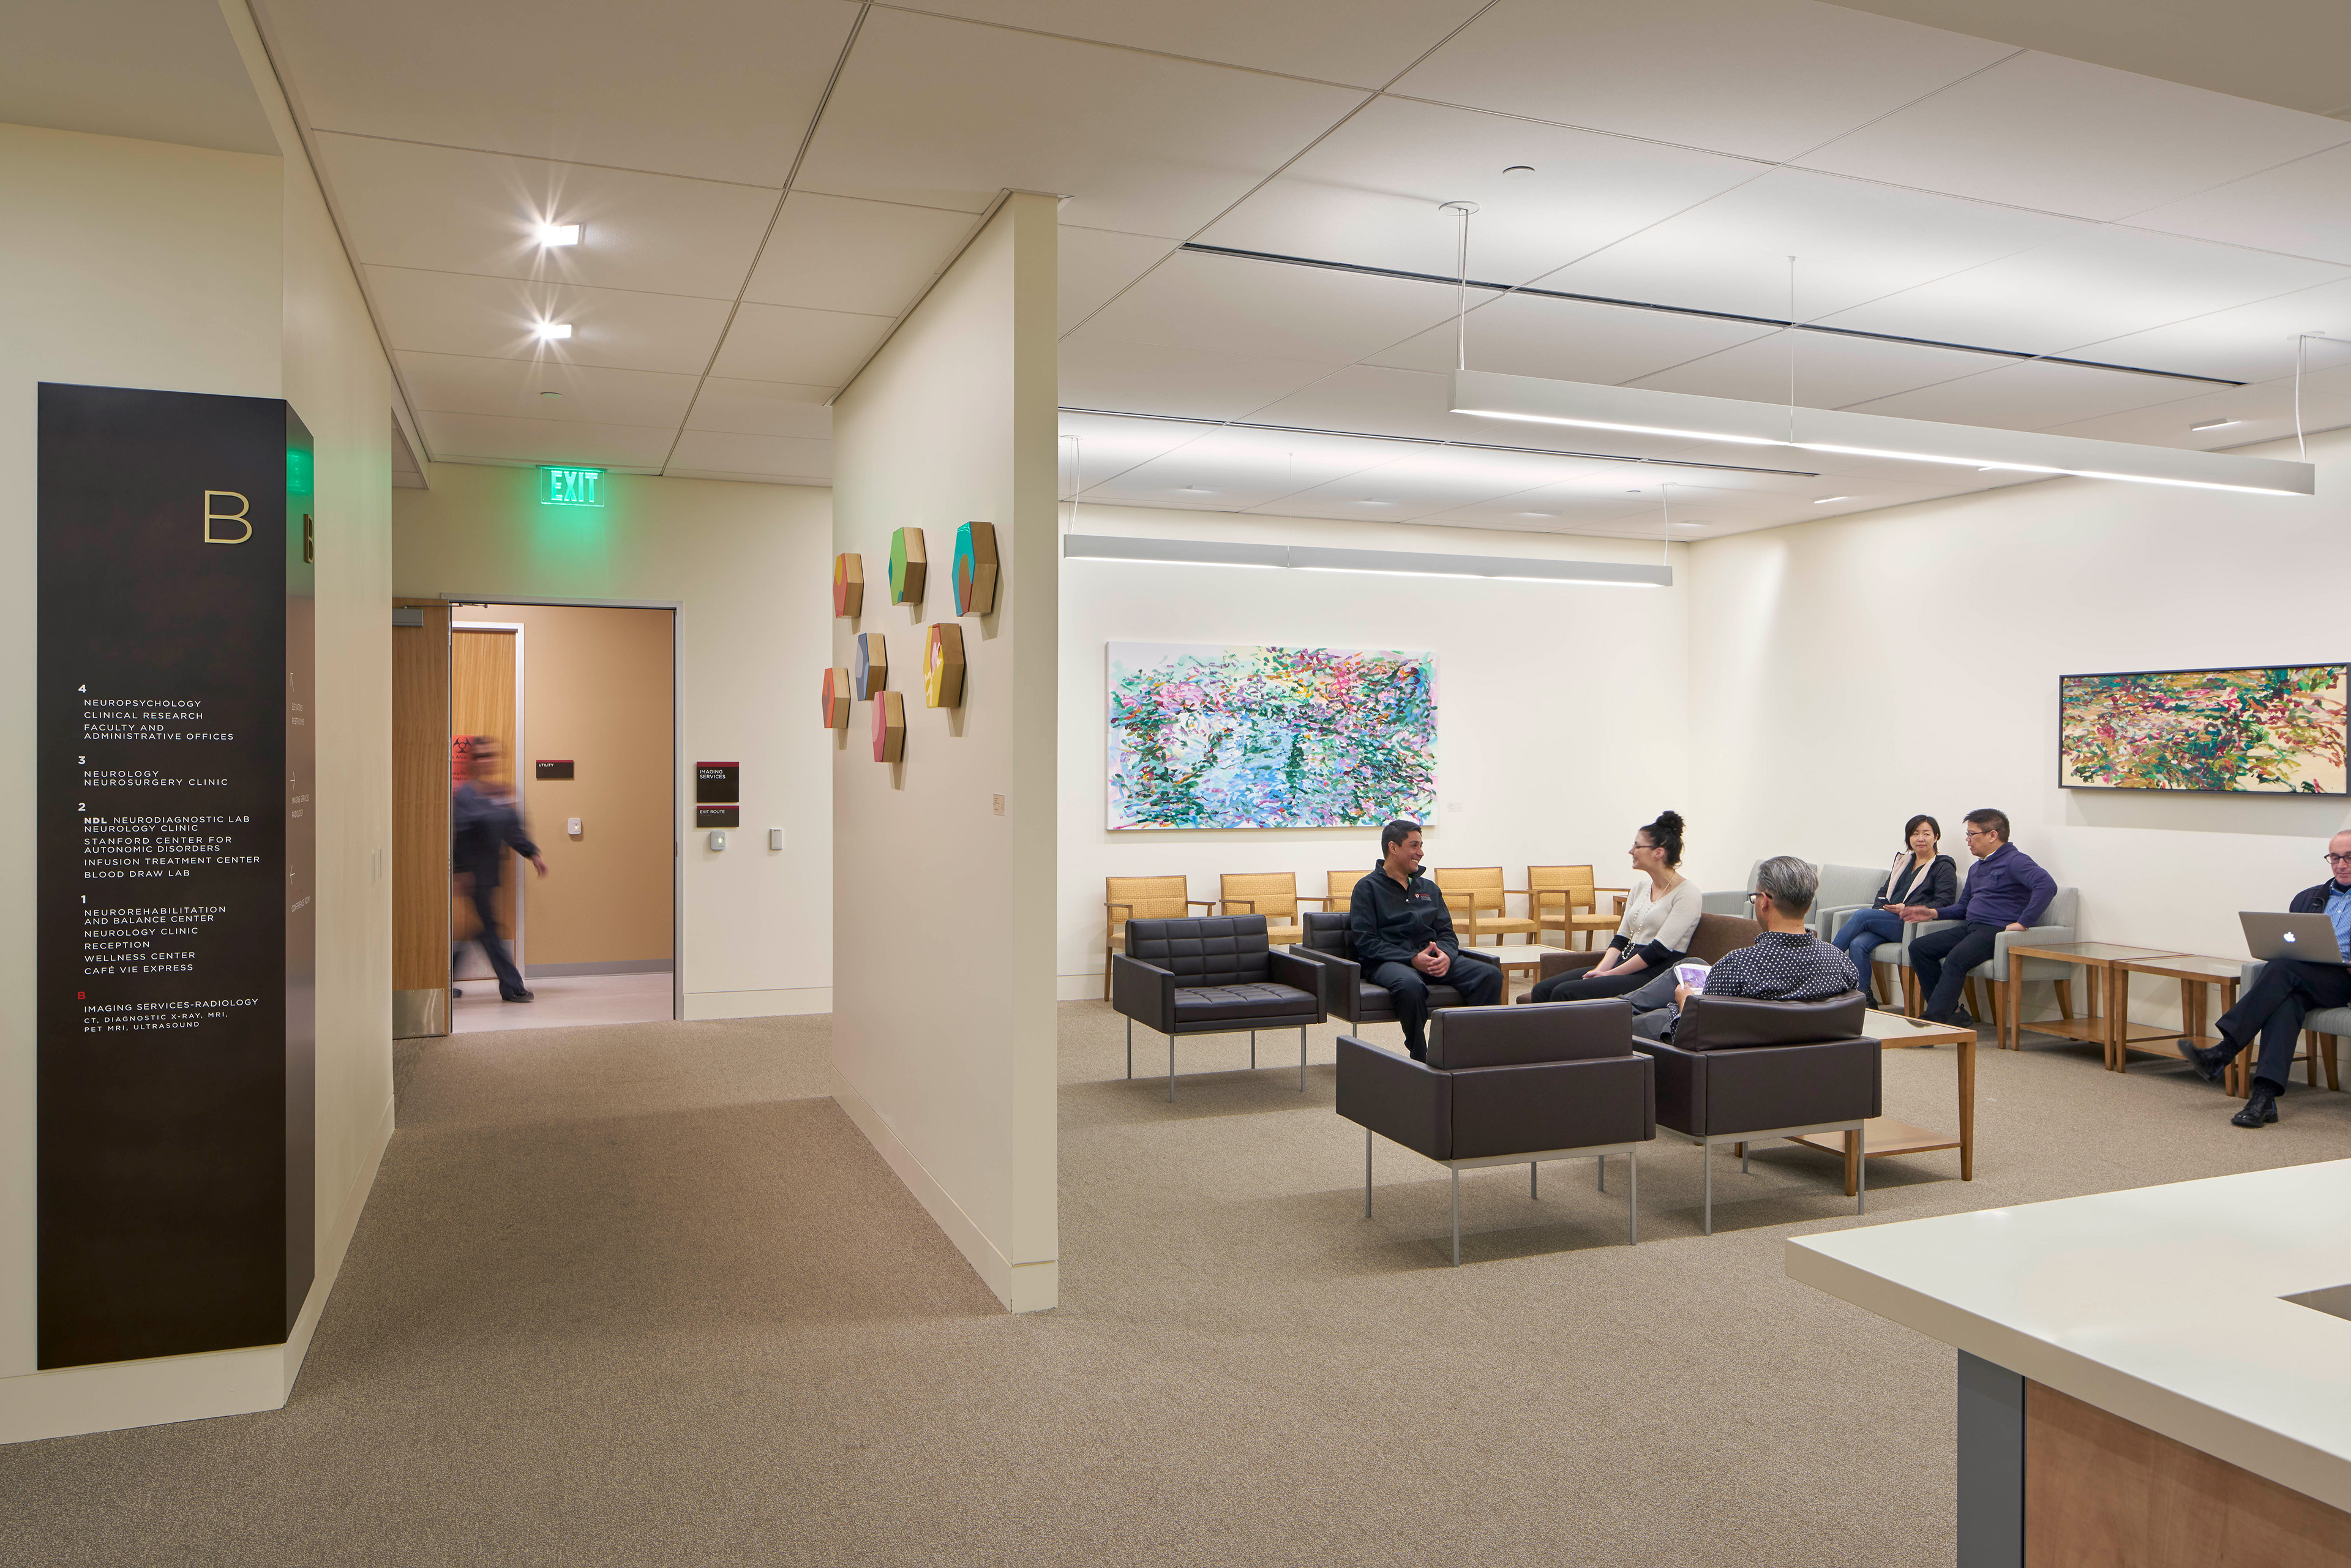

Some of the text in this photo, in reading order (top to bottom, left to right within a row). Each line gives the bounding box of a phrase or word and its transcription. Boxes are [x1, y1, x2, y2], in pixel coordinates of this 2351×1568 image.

[551, 470, 598, 503] EXIT
[204, 490, 252, 544] B
[78, 685, 87, 693] 4
[84, 699, 201, 708] NEUROPSYCHOLOGY
[78, 756, 86, 765] 3
[78, 803, 86, 811] 2
[84, 837, 149, 846] STANFORD
[84, 844, 220, 854] AUTONOMIC DISORDERS
[84, 858, 140, 866] INFUSION
[145, 857, 212, 865] TREATMENT
[81, 895, 86, 904] 1
[84, 906, 226, 917] NEUROREHABILITATION
[113, 916, 166, 925] BALANCE
[84, 927, 198, 937] NEUROLOGY CLINIC
[84, 941, 149, 950] RECEPTION
[84, 951, 195, 962] WELLNESS CENTER
[84, 966, 114, 975] CAFÉ
[143, 964, 193, 973] EXPRESS
[84, 998, 258, 1013] IMAGING SERVICES-RADIOLOGY
[104, 1014, 166, 1023] DIAGNOSTIC
[133, 1021, 200, 1030] ULTRASOUND
